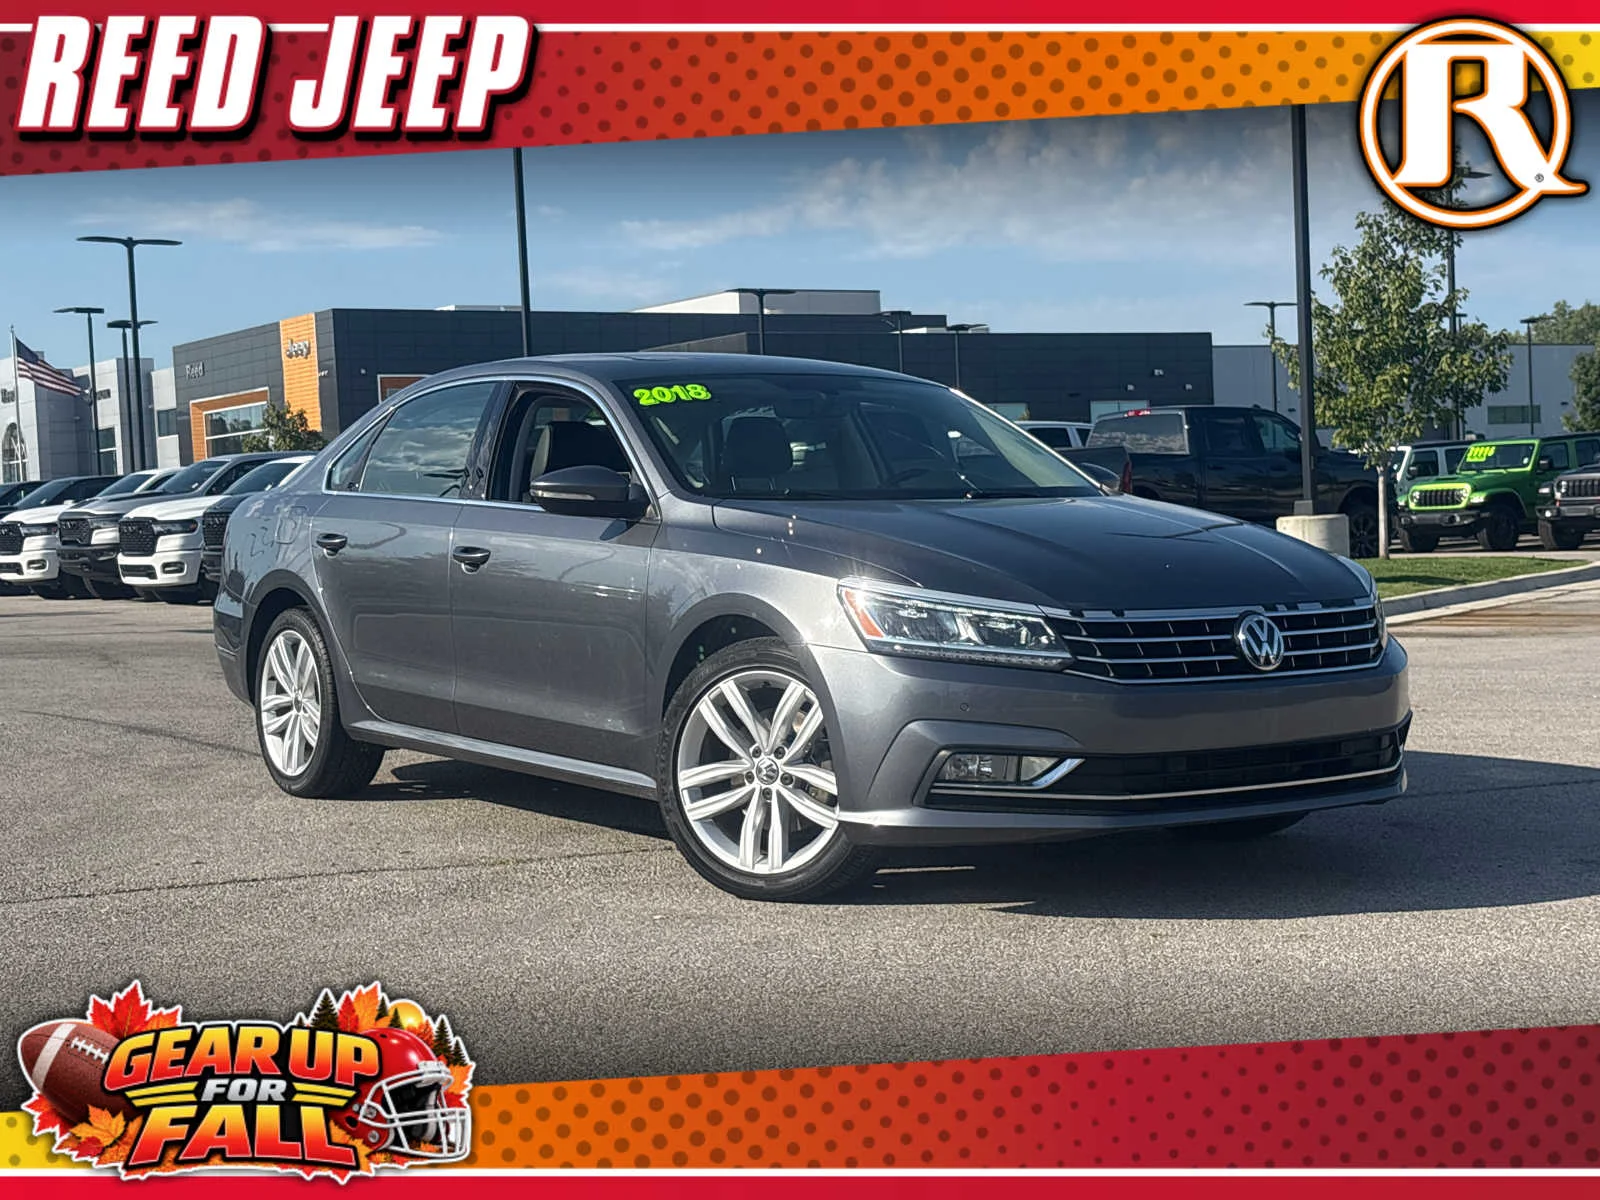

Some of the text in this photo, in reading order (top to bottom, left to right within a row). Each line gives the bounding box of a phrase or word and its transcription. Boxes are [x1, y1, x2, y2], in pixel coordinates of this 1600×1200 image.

[286, 339, 310, 359] Jeep
[185, 361, 206, 379] Reed
[633, 384, 712, 406] 2018
[1241, 615, 1283, 669] VW
